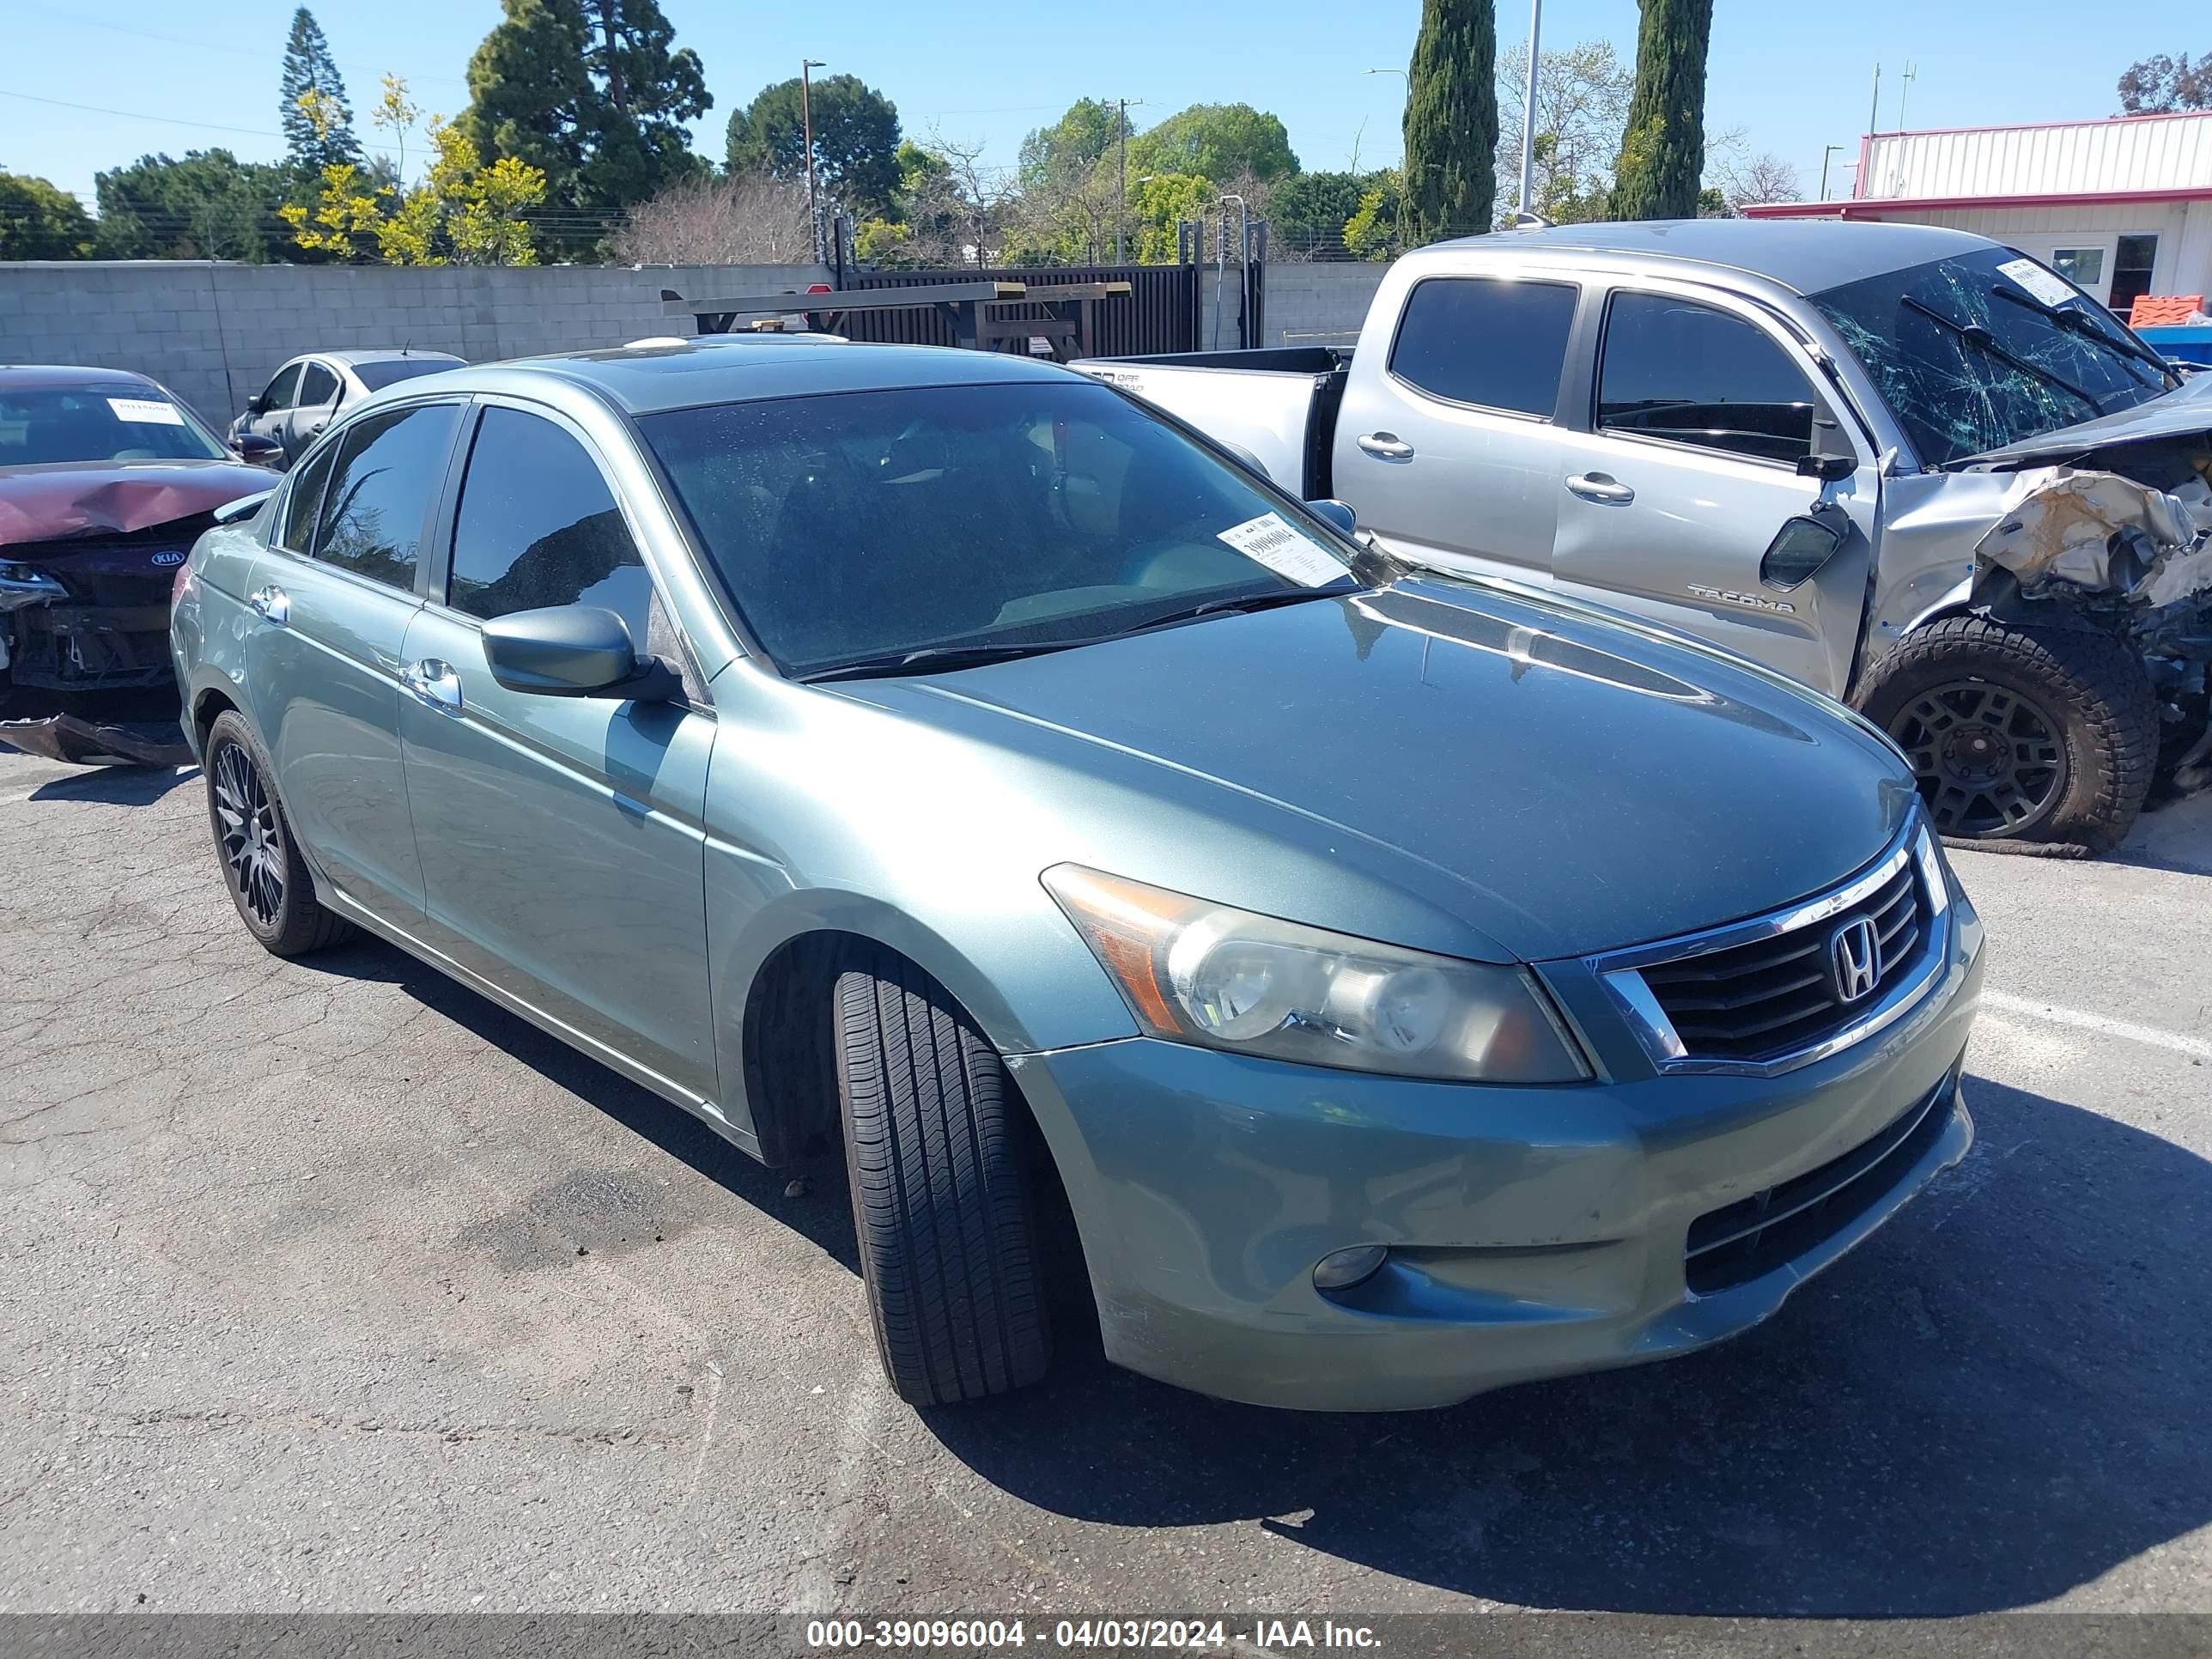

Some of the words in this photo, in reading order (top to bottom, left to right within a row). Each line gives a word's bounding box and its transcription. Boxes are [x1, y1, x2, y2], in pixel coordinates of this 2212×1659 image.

[1117, 374, 1139, 382] OFF
[1244, 528, 1296, 556] 39096004
[157, 553, 180, 563] KIA
[1686, 585, 1796, 613] TACOMA
